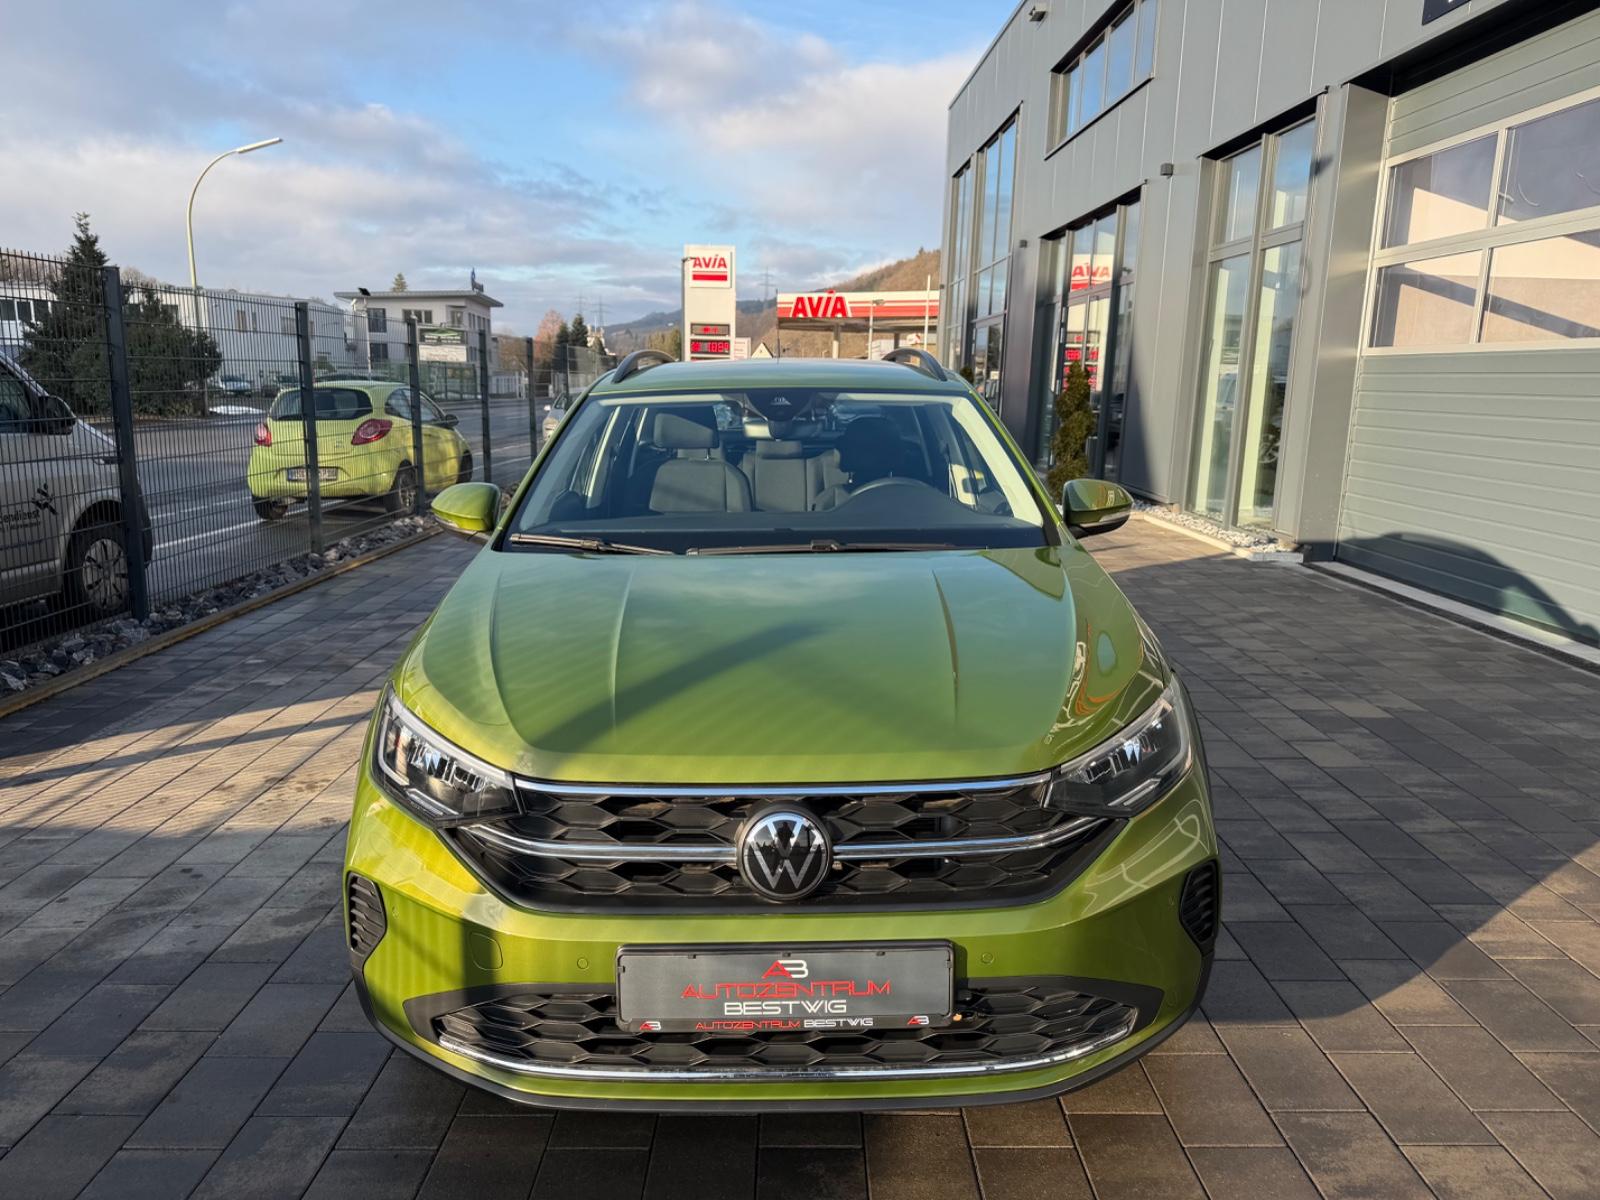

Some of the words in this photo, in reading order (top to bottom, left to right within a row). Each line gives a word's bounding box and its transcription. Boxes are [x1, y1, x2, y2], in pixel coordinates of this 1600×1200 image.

[692, 255, 727, 268] AVIA
[792, 289, 847, 318] AVIA
[680, 981, 891, 999] AUTOZENTRUM
[724, 1000, 847, 1016] BESTWIG
[695, 1020, 800, 1030] AUTOZENTRUM
[804, 1018, 873, 1028] BESTWIG
